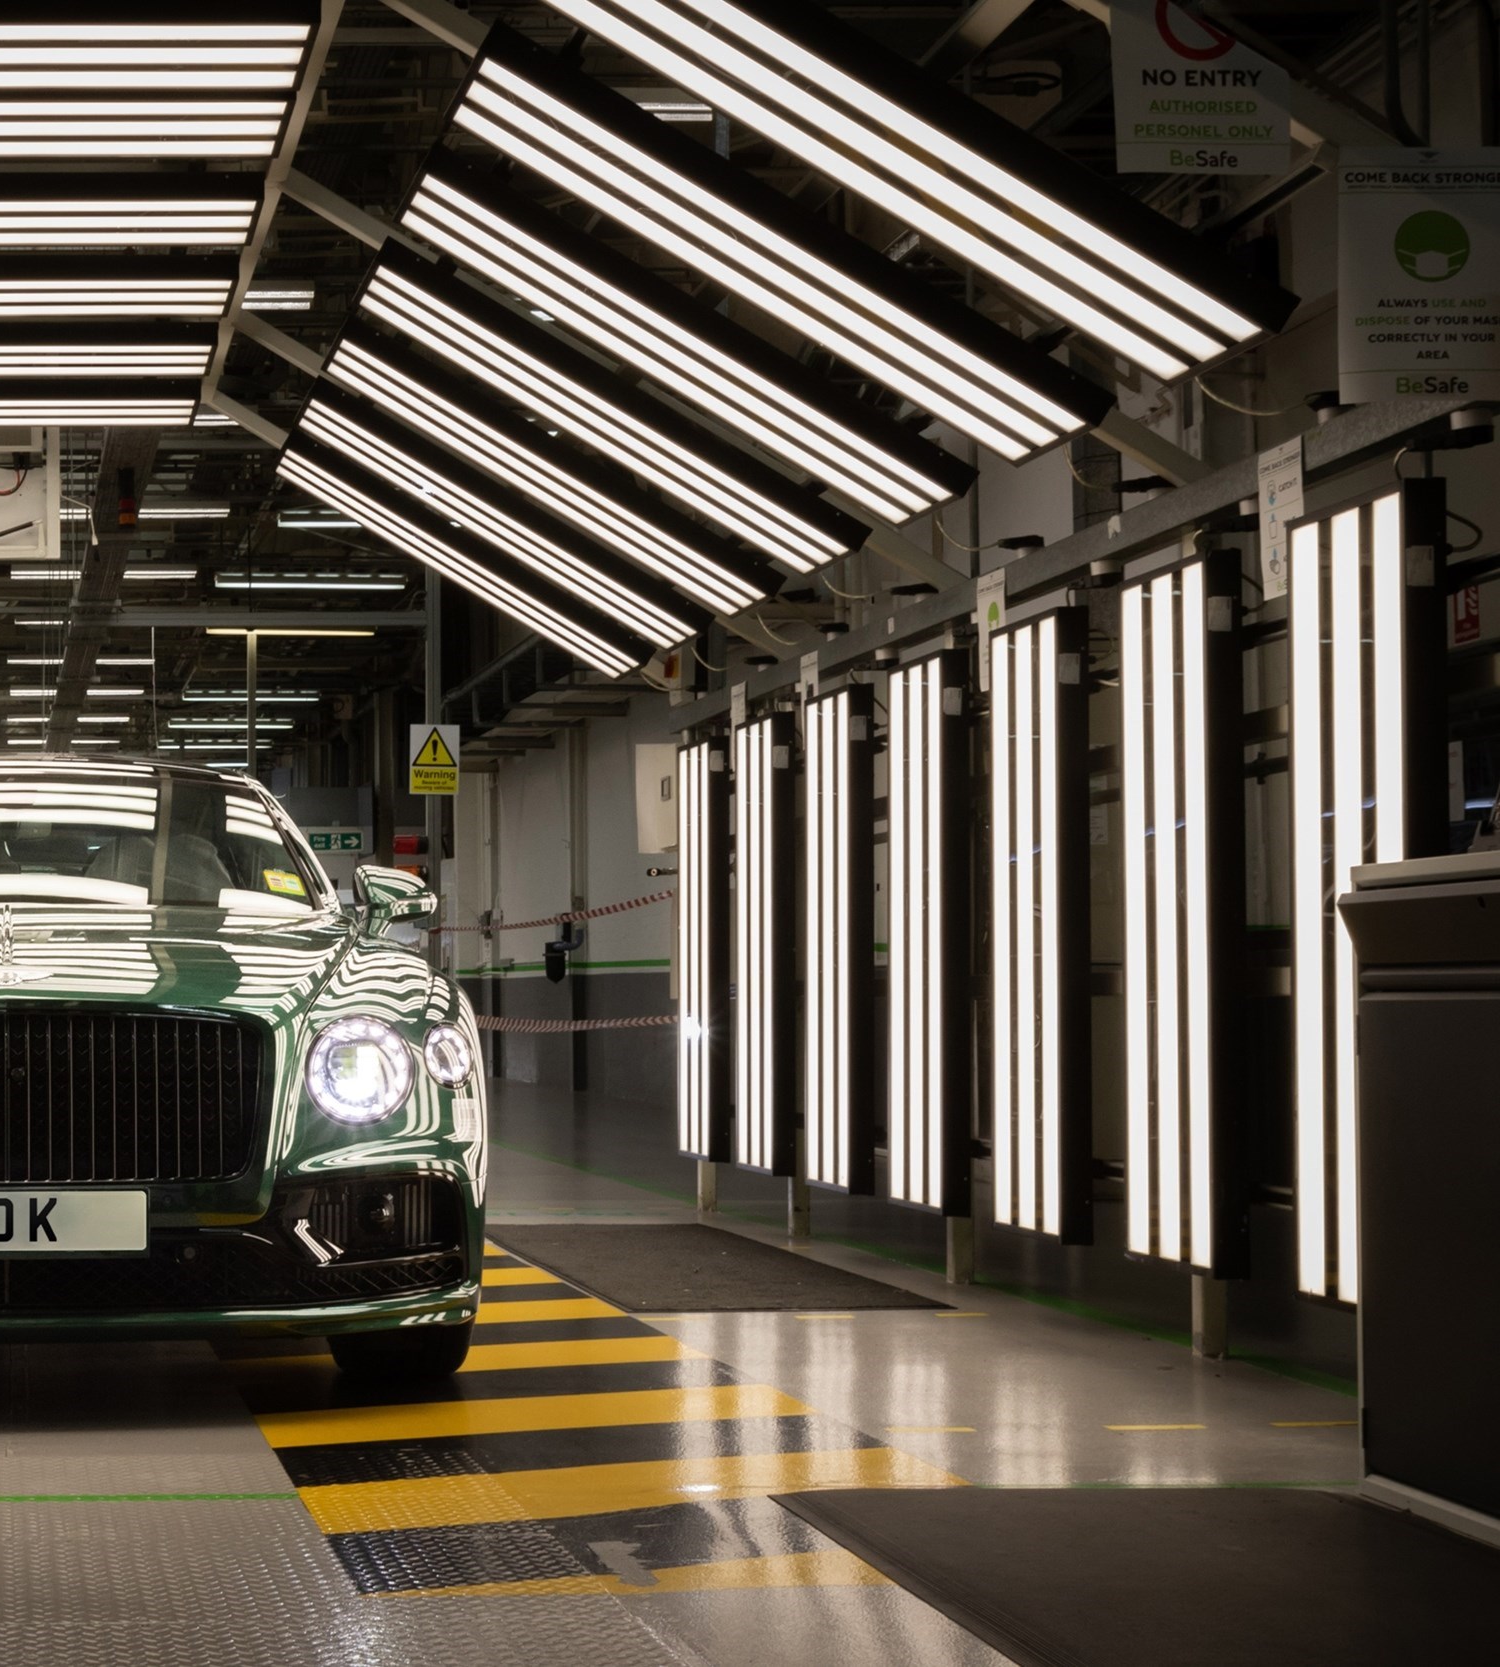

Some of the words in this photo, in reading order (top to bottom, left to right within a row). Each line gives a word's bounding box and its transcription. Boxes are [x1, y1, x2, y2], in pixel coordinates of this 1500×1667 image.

[1141, 69, 1177, 87] NO
[1185, 69, 1262, 88] ENTRY
[1148, 99, 1257, 115] AUTHORISED
[1133, 123, 1224, 138] PERSONEL
[1228, 125, 1274, 139] ONLY
[1169, 149, 1238, 168] BeSafe
[1344, 172, 1387, 184] COME
[1391, 172, 1430, 184] BACK
[1435, 172, 1500, 184] STRONG
[1377, 298, 1428, 308] ALWAYS
[1432, 298, 1456, 308] USE
[1459, 298, 1486, 308] AND
[1355, 315, 1410, 327] DISPOSE
[1414, 315, 1430, 326] OF
[1435, 315, 1469, 326] YOUR
[1472, 315, 1500, 326] MAS
[1368, 333, 1441, 344] CORRECTLY
[1444, 333, 1457, 343] IN
[1461, 332, 1496, 343] YOUR
[1416, 350, 1450, 360] AREA
[1395, 376, 1469, 394] BeSafe
[413, 769, 456, 781] Warning
[29, 1198, 58, 1243] K
